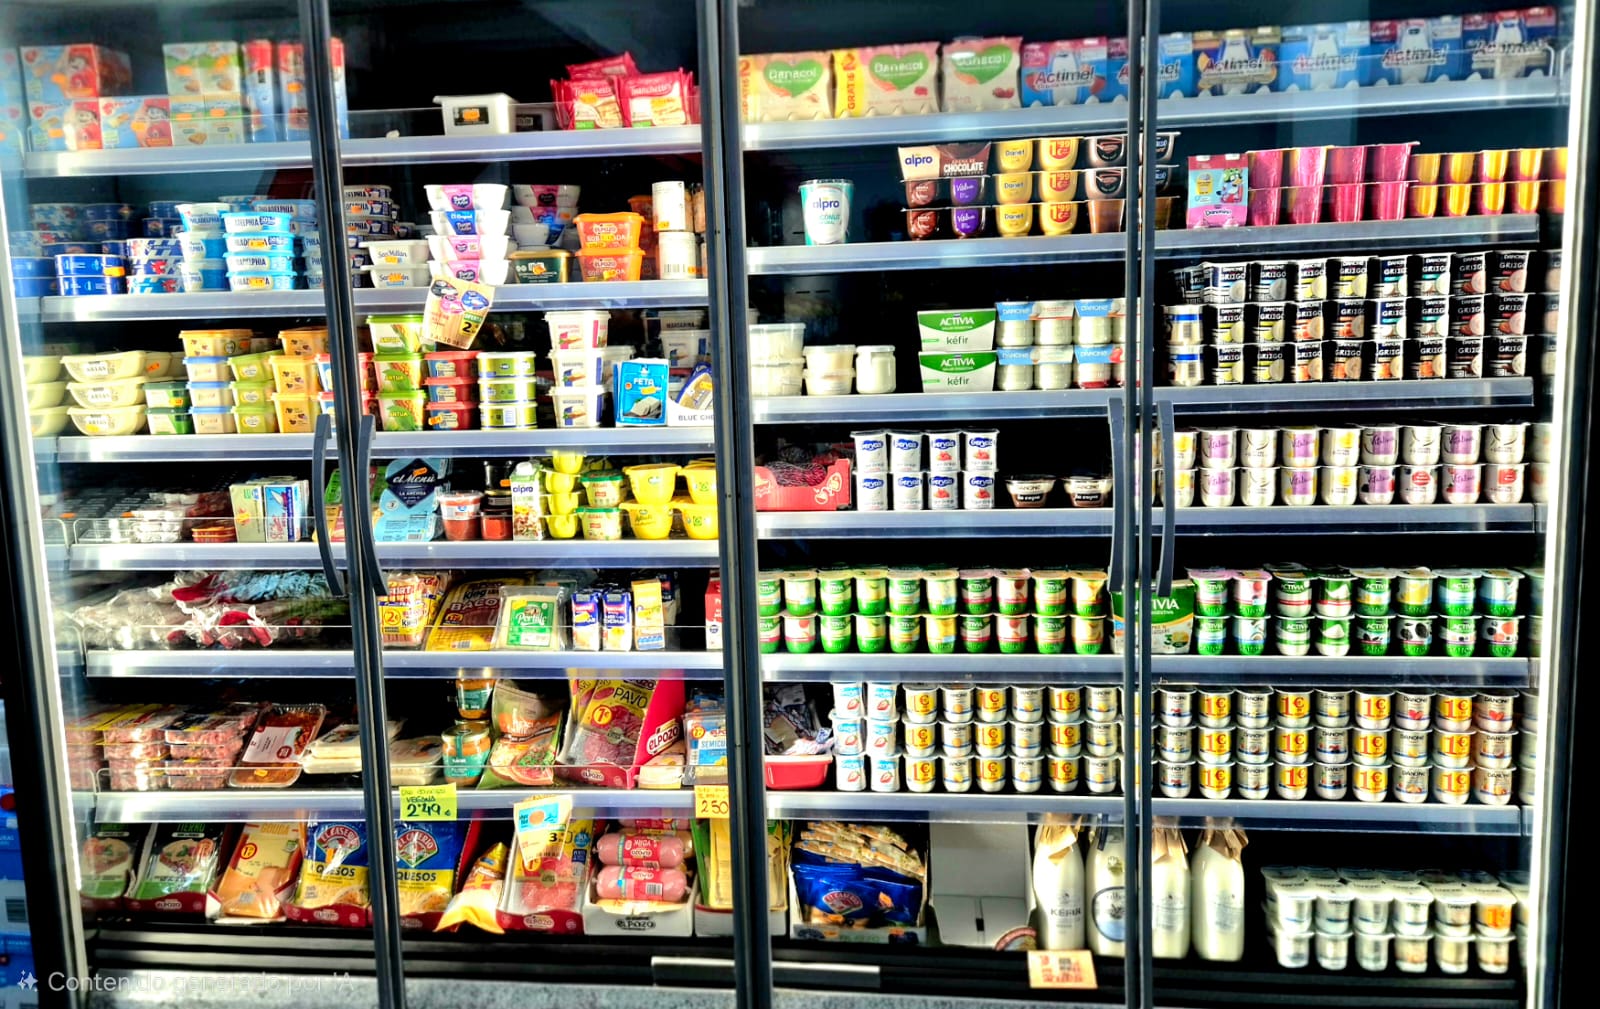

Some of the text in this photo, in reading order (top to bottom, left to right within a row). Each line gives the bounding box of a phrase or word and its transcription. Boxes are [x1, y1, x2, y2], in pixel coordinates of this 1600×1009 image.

[1294, 52, 1358, 68] Actimel
[1381, 44, 1450, 64] Actimel
[874, 60, 925, 75] Danacol
[1204, 56, 1265, 73] Actimel
[769, 67, 818, 81] Danacol
[1035, 66, 1095, 84] Actimel
[846, 73, 857, 111] GRATIS
[1005, 149, 1026, 157] Danet
[905, 155, 933, 167] alpro
[944, 161, 985, 173] CHOCOLATE
[1004, 180, 1025, 190] Danet
[813, 198, 840, 211] alpro
[1004, 212, 1024, 221] Danet
[940, 316, 975, 326] ACTIVIA
[946, 336, 969, 345] kéfir
[941, 357, 976, 367] ACTIVIA
[947, 376, 970, 386] kéfir
[512, 486, 534, 495] alpro
[450, 598, 498, 611] BACO
[612, 687, 648, 708] PAVO
[649, 727, 679, 751] ELPOZO
[261, 823, 290, 835] GOUDA
[396, 872, 436, 882] QUESOS
[616, 919, 655, 929] ELPOZO
